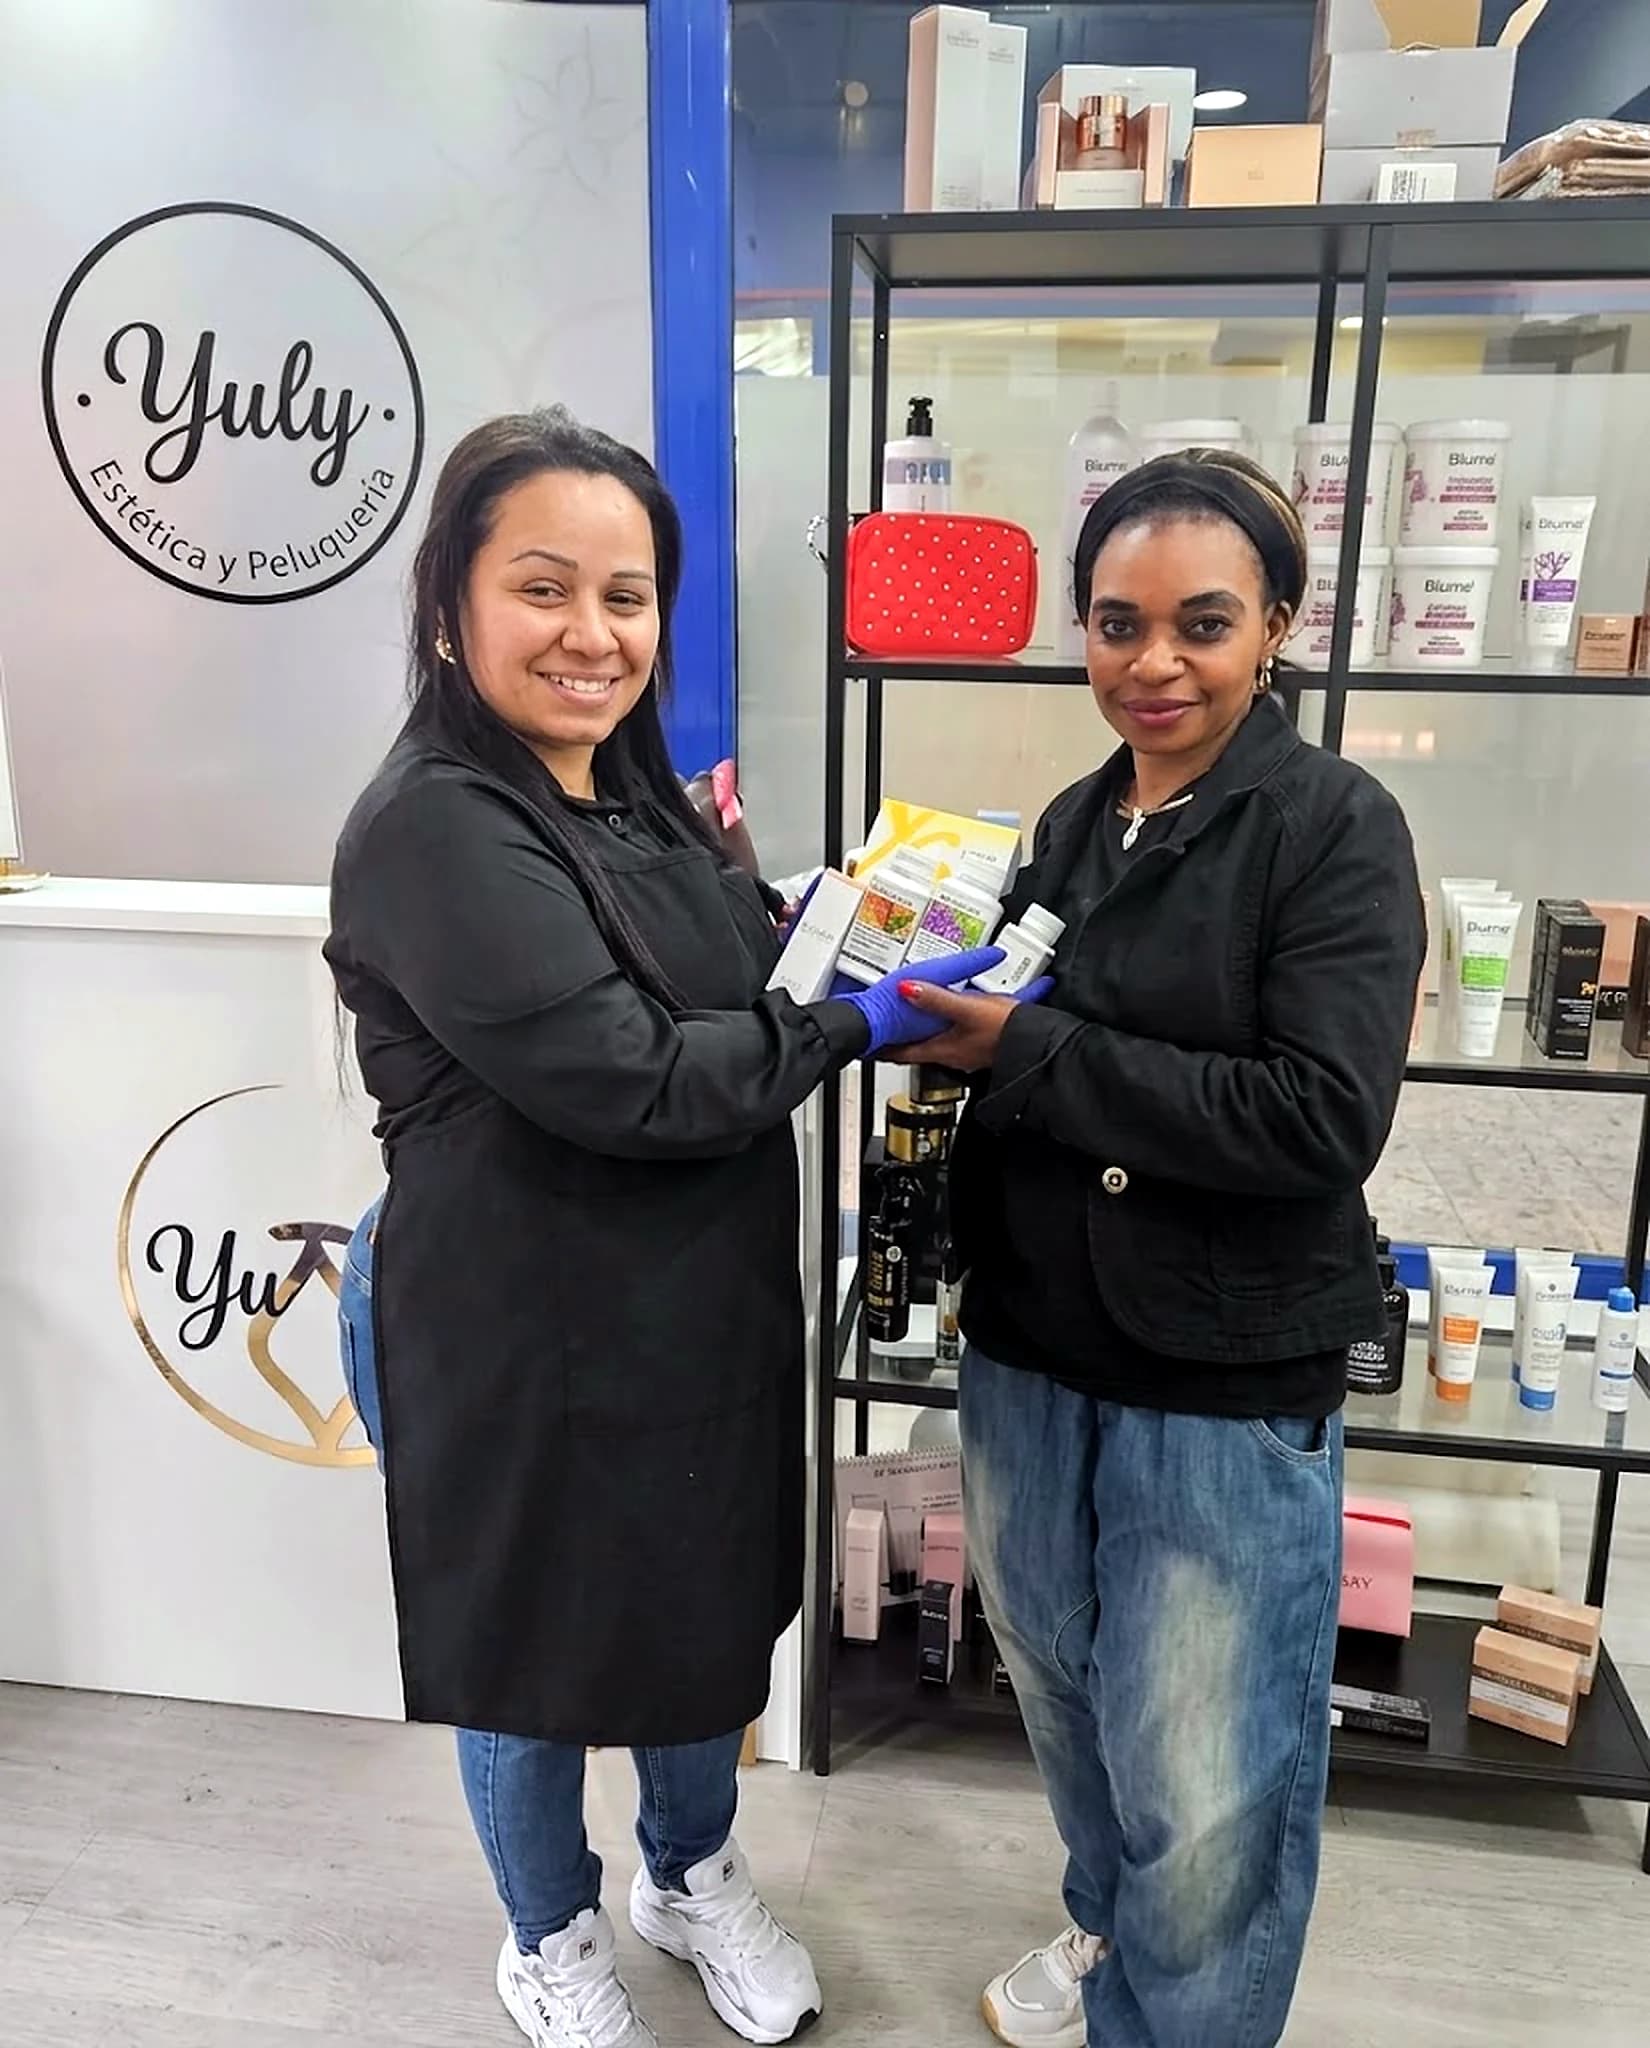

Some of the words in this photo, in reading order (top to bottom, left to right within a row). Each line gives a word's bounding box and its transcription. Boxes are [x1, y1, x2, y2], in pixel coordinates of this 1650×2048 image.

[104, 322, 369, 487] Yuly
[90, 460, 206, 570] Estética
[218, 555, 237, 584] y
[249, 468, 394, 580] Peluquería
